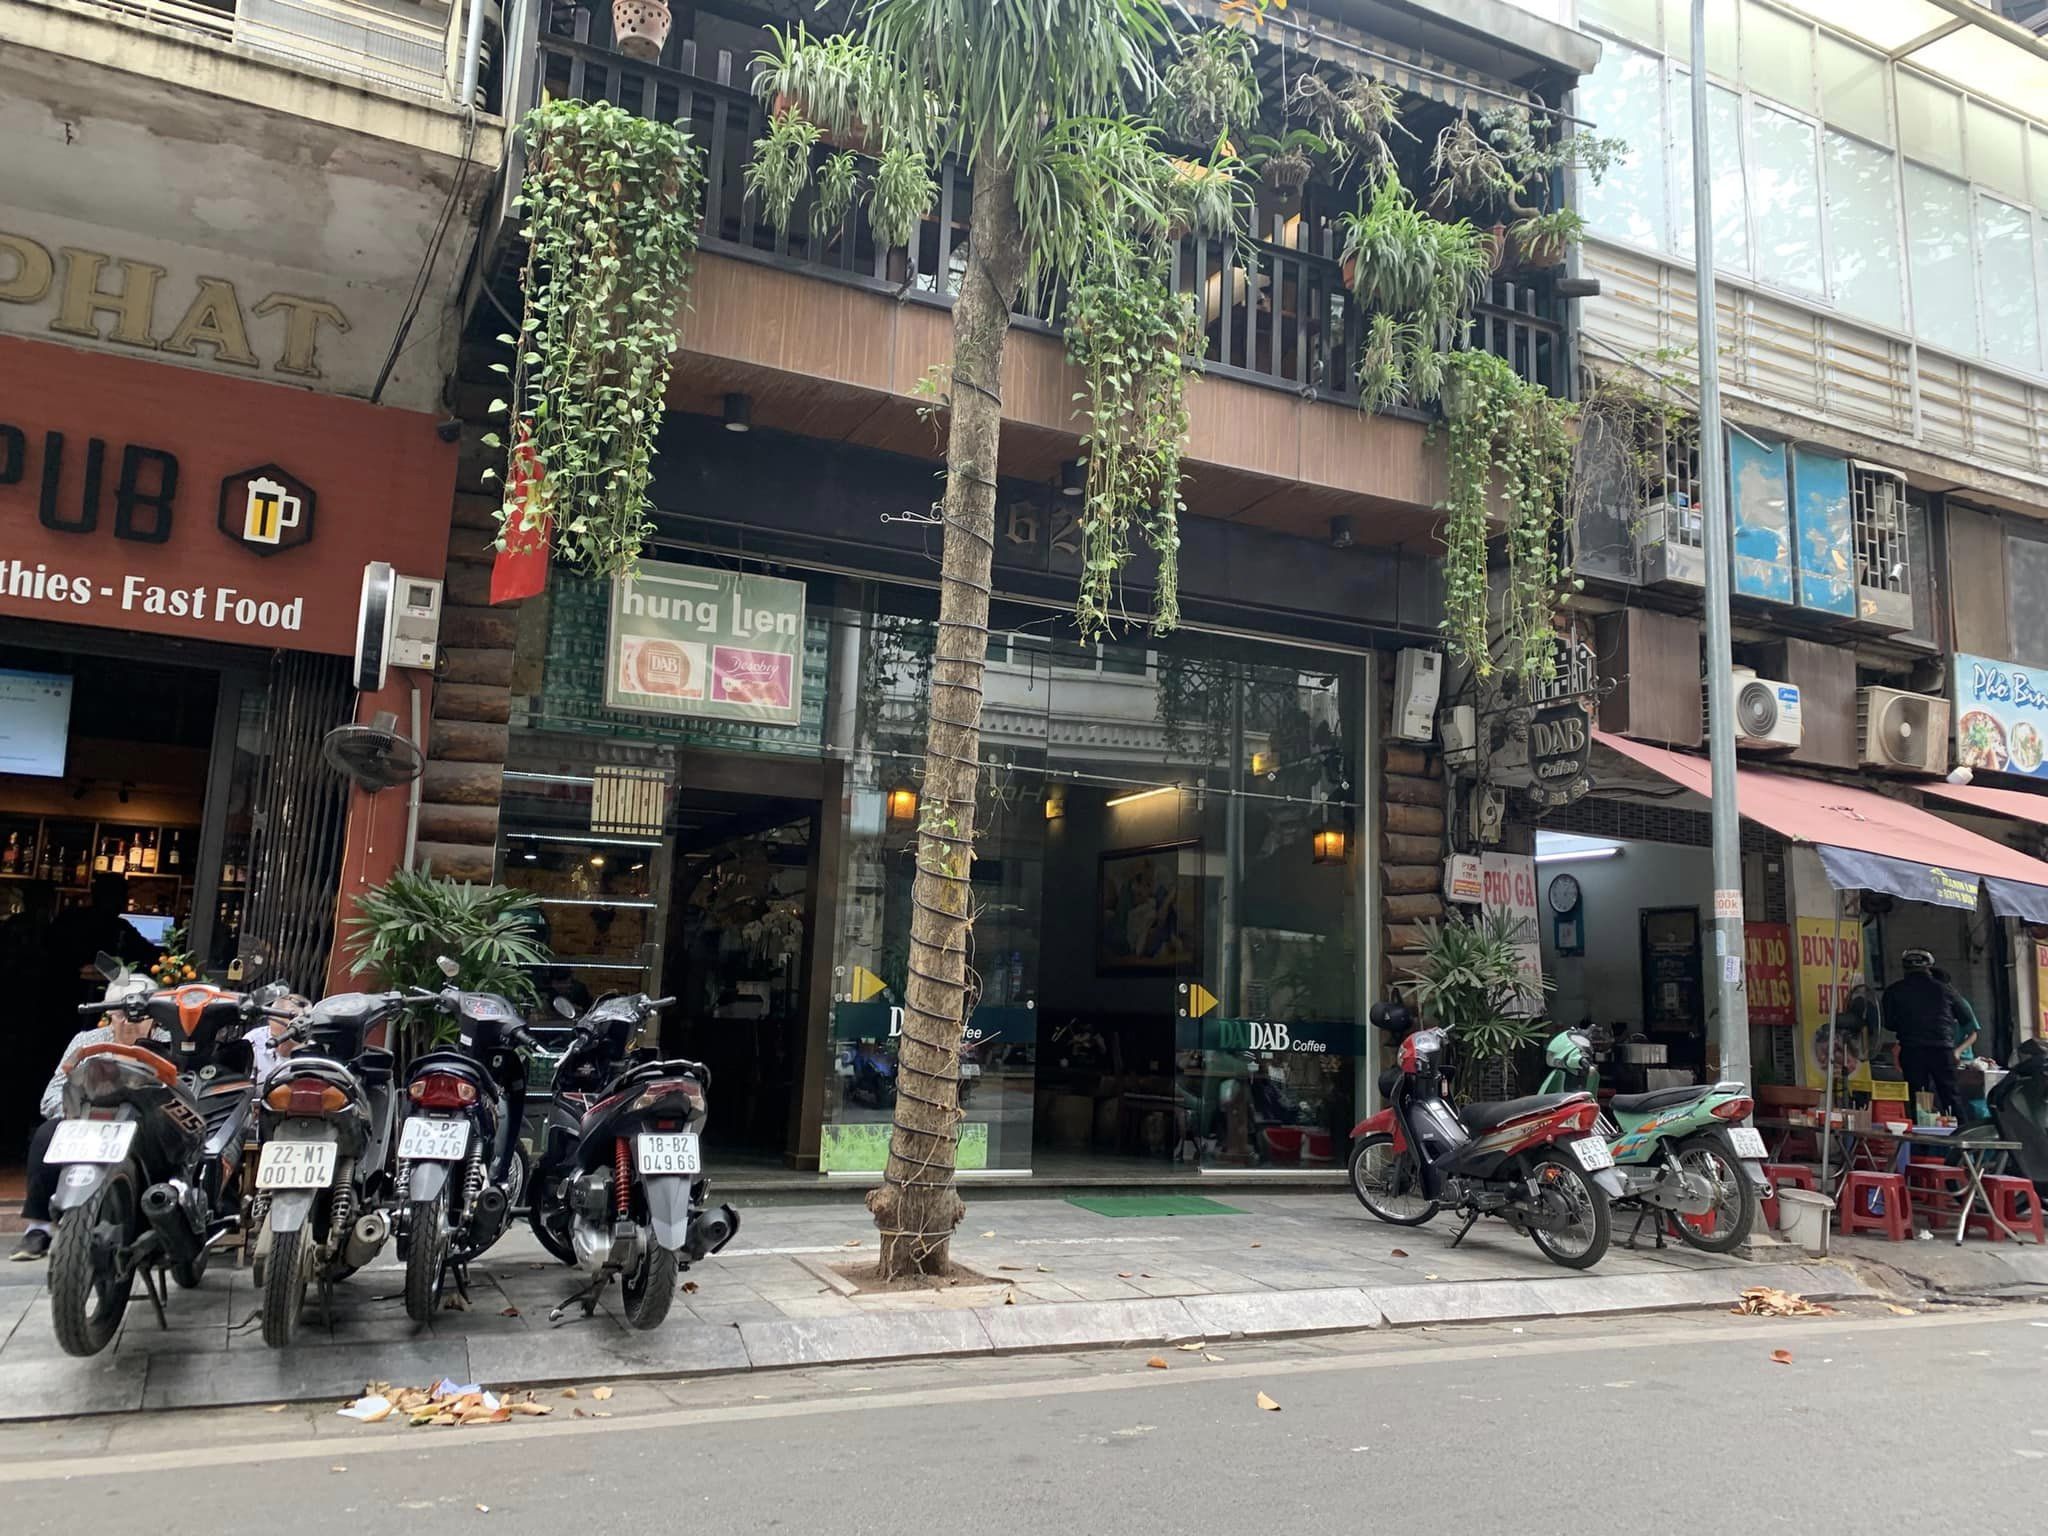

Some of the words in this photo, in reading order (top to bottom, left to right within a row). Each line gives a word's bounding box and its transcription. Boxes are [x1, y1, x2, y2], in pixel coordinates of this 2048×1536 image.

[121, 575, 207, 620] Fast
[214, 587, 304, 631] Food
[651, 655, 679, 674] DAB
[1531, 717, 1585, 757] DAB
[1748, 978, 1768, 1007] AM
[1249, 1022, 1290, 1051] DAB
[1292, 1039, 1327, 1053] Coffee
[404, 1139, 462, 1157] 943.46
[648, 1136, 689, 1153] 18-B2
[272, 1146, 324, 1164] 22-N1
[262, 1166, 327, 1185] 001.04
